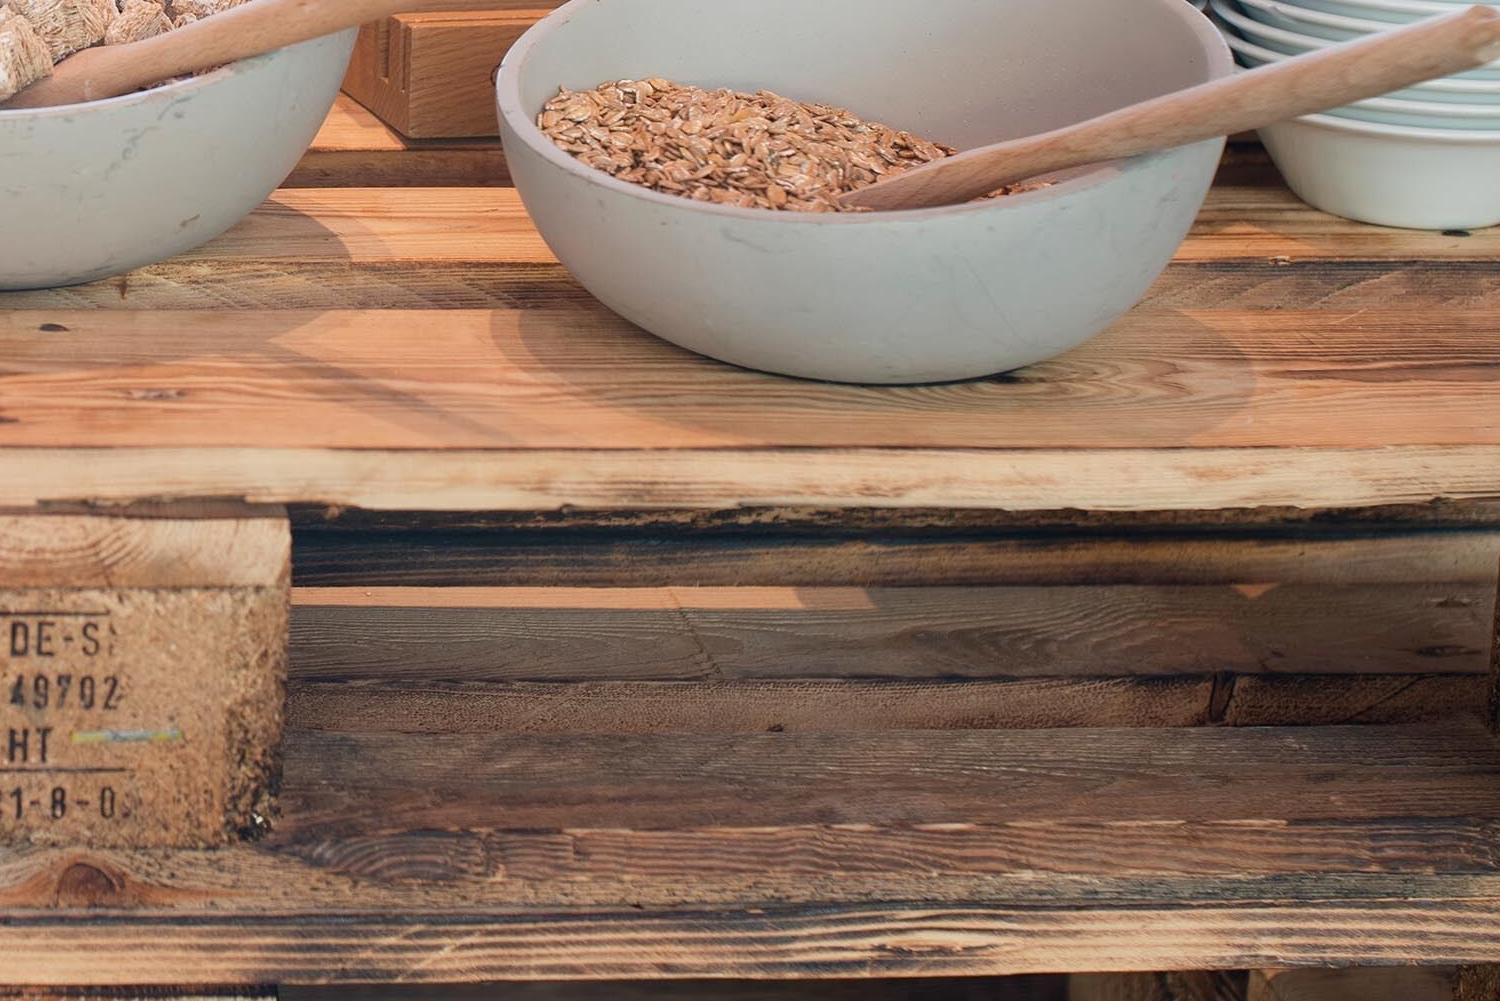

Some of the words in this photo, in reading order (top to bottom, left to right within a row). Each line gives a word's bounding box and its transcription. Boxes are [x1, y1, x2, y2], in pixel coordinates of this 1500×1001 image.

[10, 621, 117, 657] DE-S
[10, 675, 120, 710] 49702
[8, 728, 53, 762] HT
